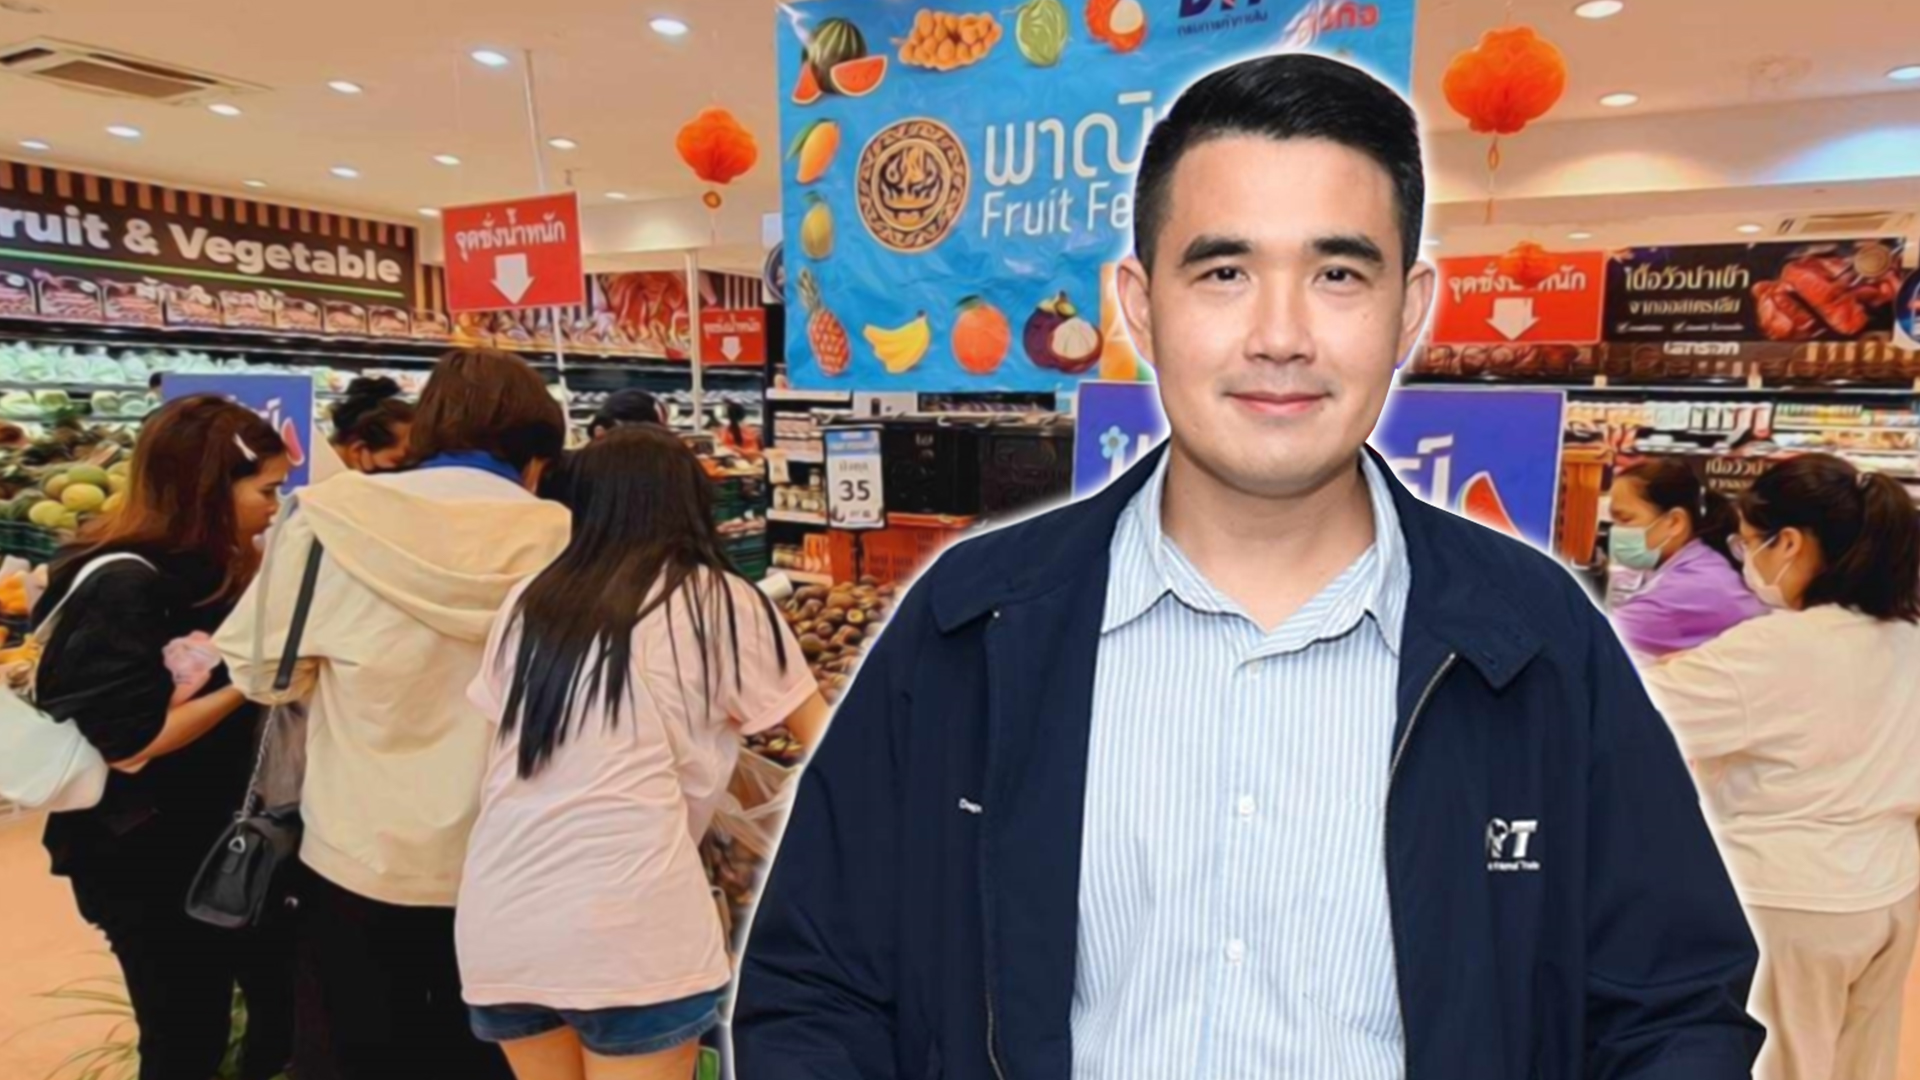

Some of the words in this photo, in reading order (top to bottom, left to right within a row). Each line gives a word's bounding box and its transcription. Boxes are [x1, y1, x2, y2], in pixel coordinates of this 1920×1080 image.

[455, 207, 566, 263] จุดชั่งน้ำหนัก
[982, 188, 1075, 238] Fruit
[123, 218, 160, 256] &
[167, 223, 401, 284] Vegetable
[840, 479, 871, 502] 35
